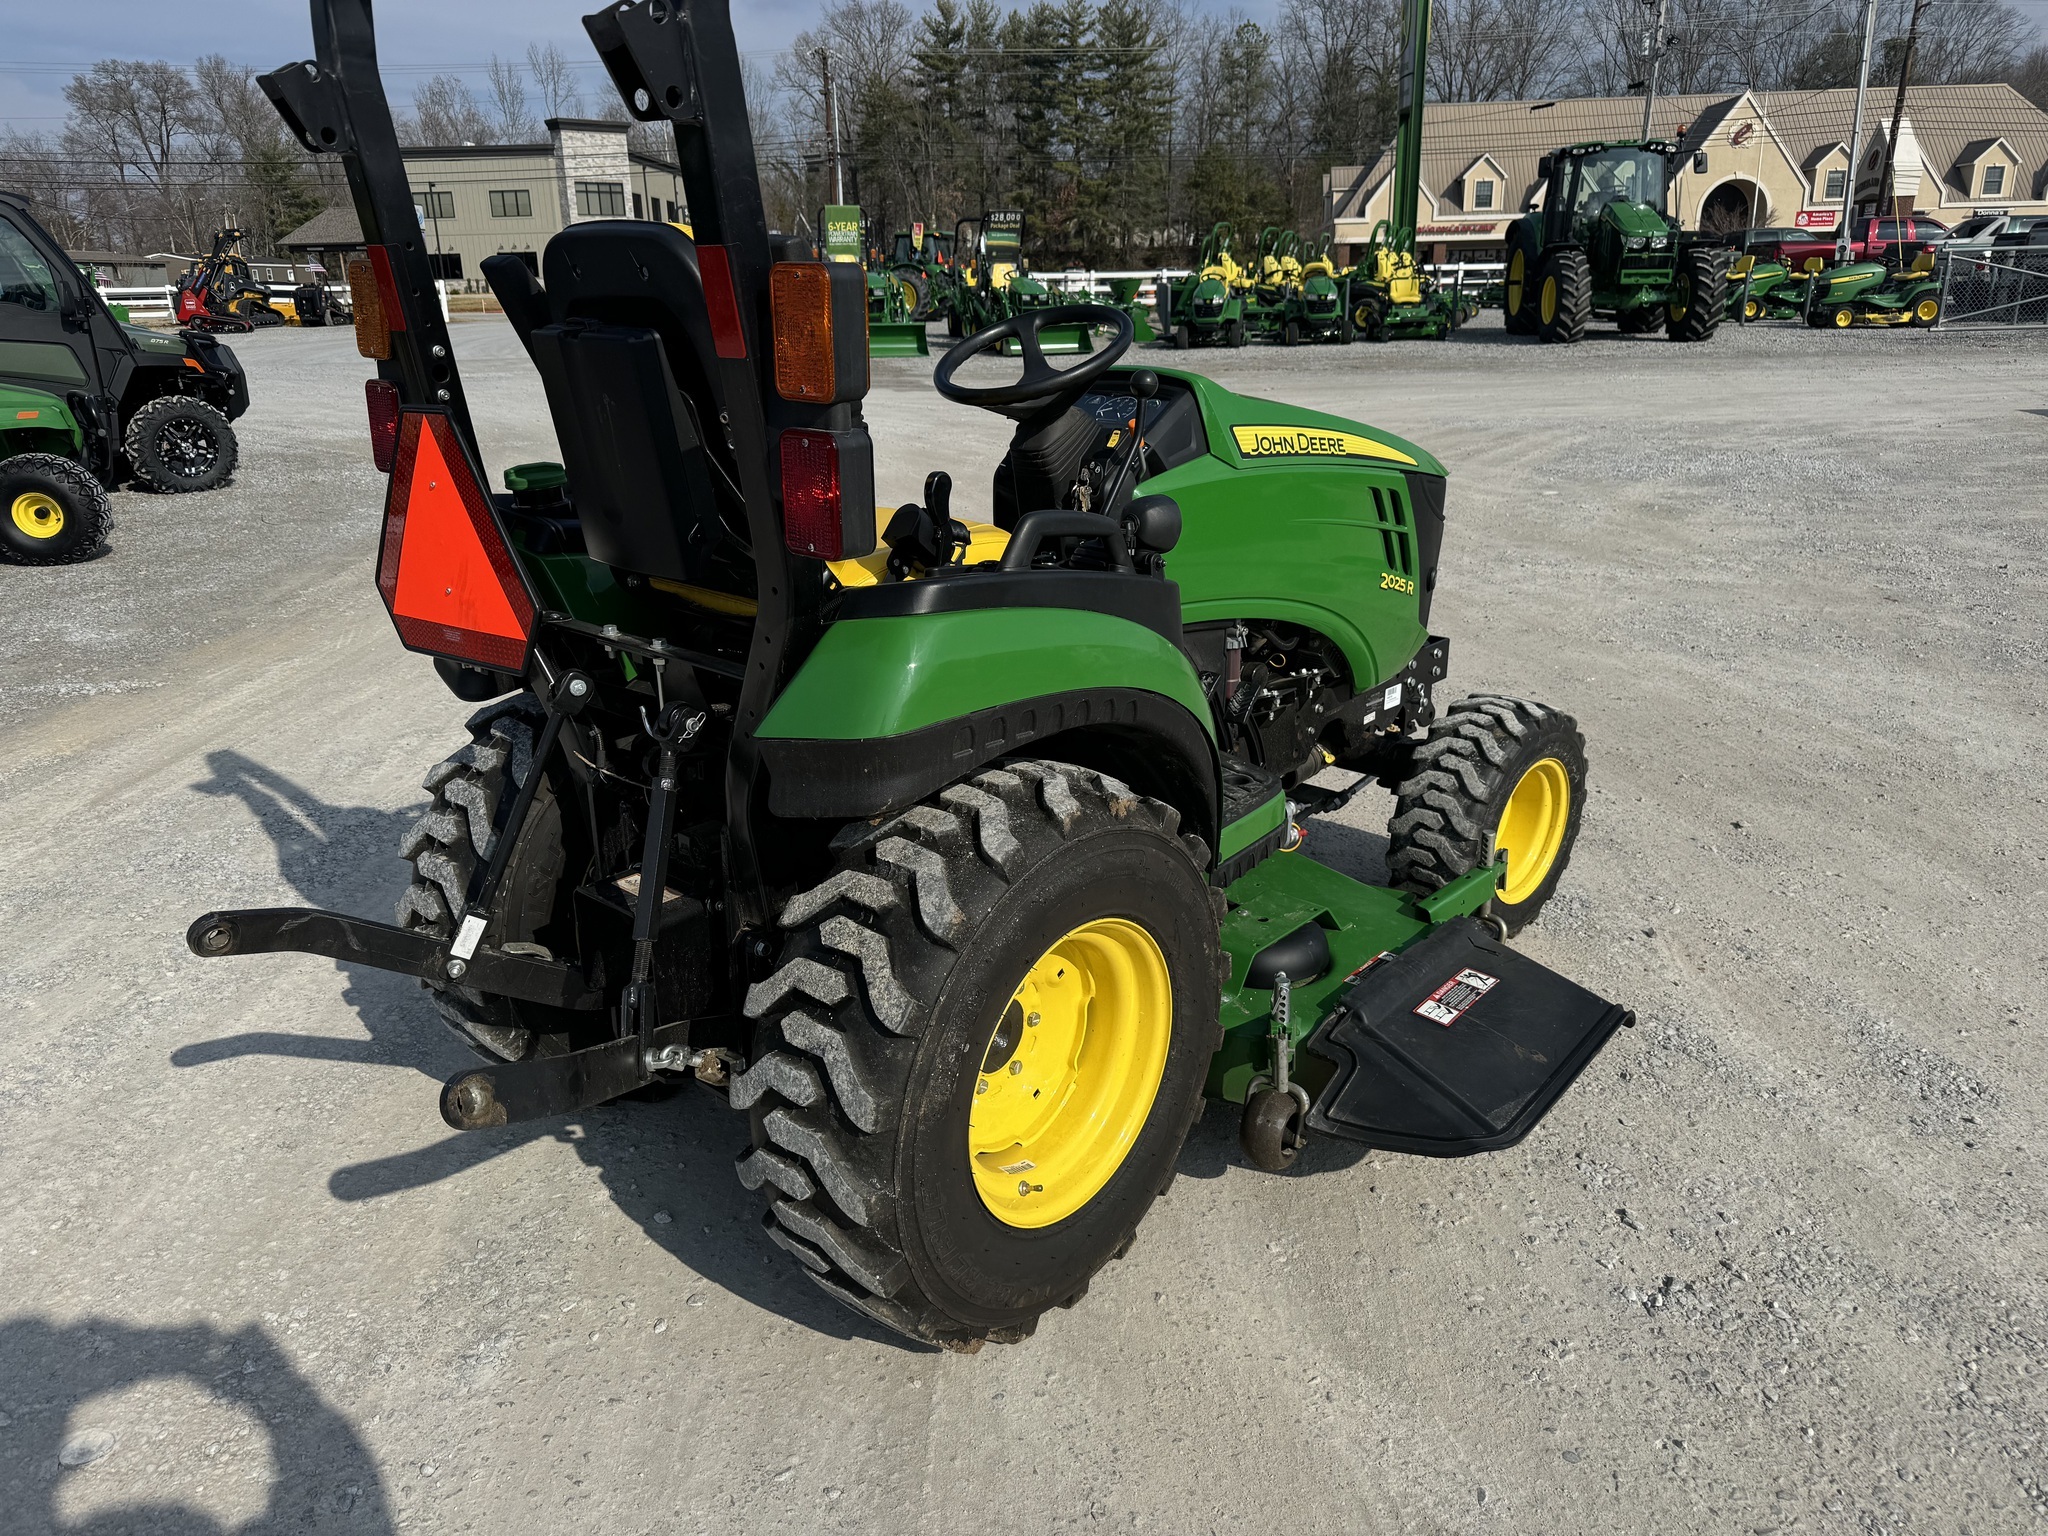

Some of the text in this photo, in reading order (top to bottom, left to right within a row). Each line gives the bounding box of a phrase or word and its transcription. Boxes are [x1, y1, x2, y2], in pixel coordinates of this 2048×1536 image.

[990, 213, 1021, 223] $28,000
[827, 221, 858, 231] 6-YEAR
[1251, 433, 1346, 453] JOHN DEERE
[1435, 980, 1456, 996] DANGER
